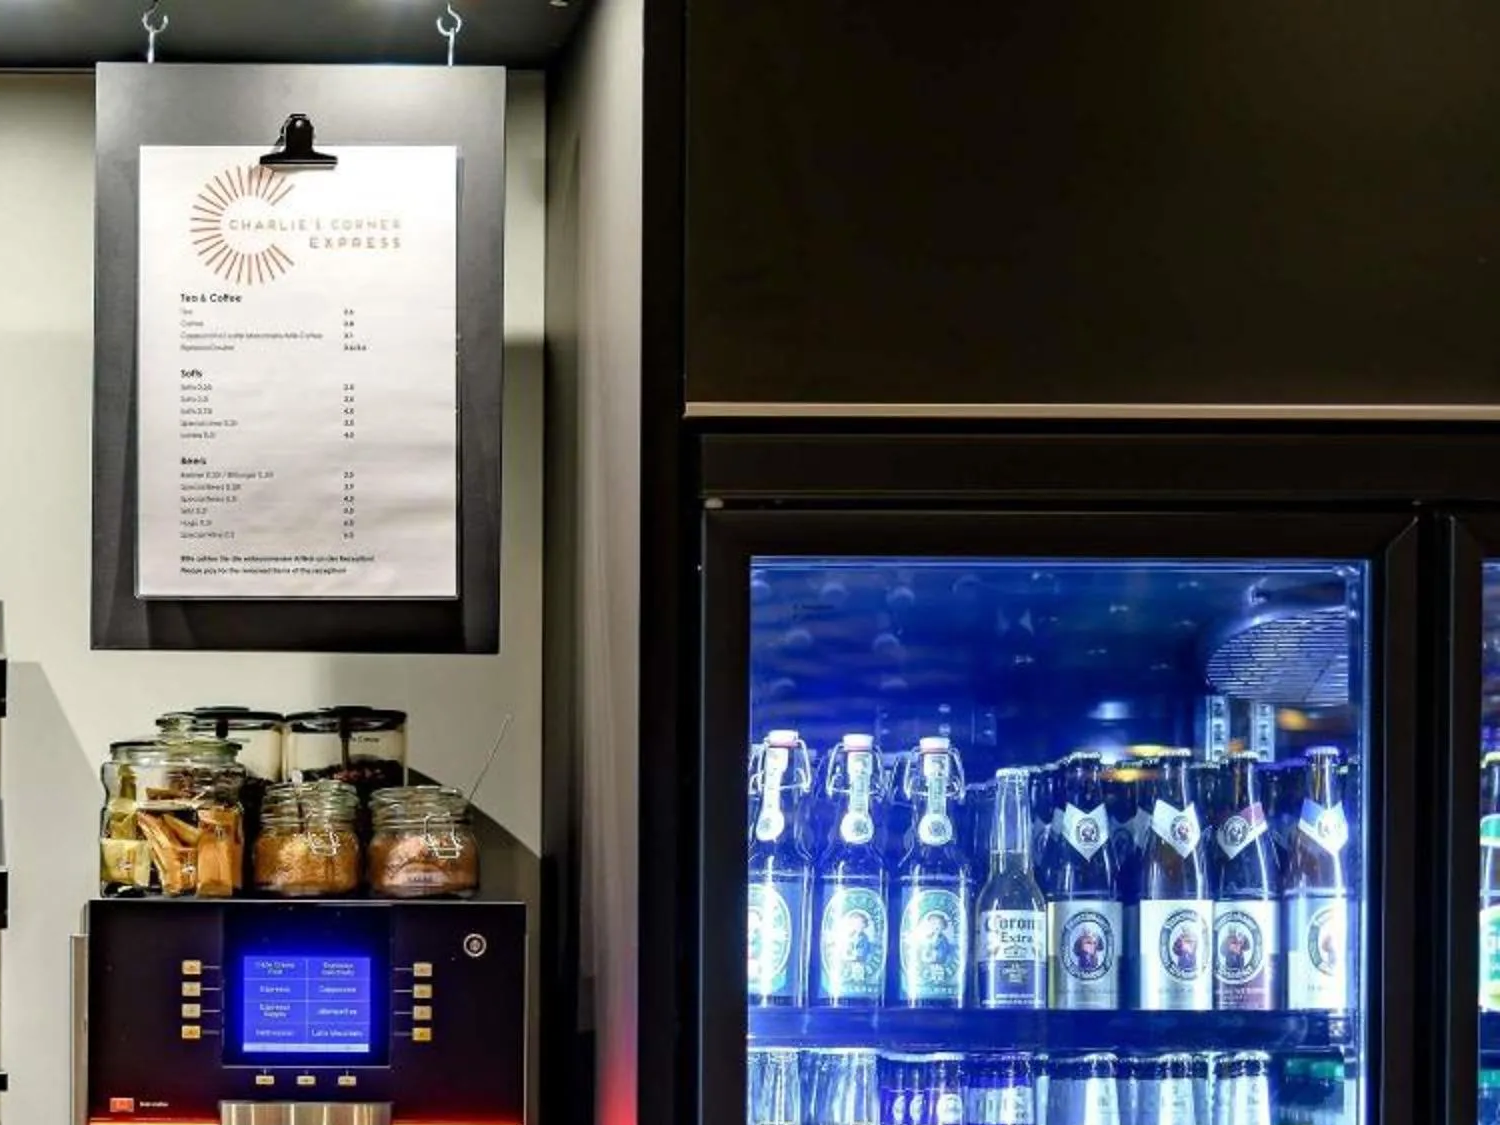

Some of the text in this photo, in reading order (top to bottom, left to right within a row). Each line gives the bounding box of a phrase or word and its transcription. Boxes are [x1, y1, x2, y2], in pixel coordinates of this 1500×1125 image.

[309, 236, 401, 249] EXPRESS
[180, 293, 198, 303] Tea
[209, 293, 242, 303] Coffee
[985, 914, 1035, 932] Coron
